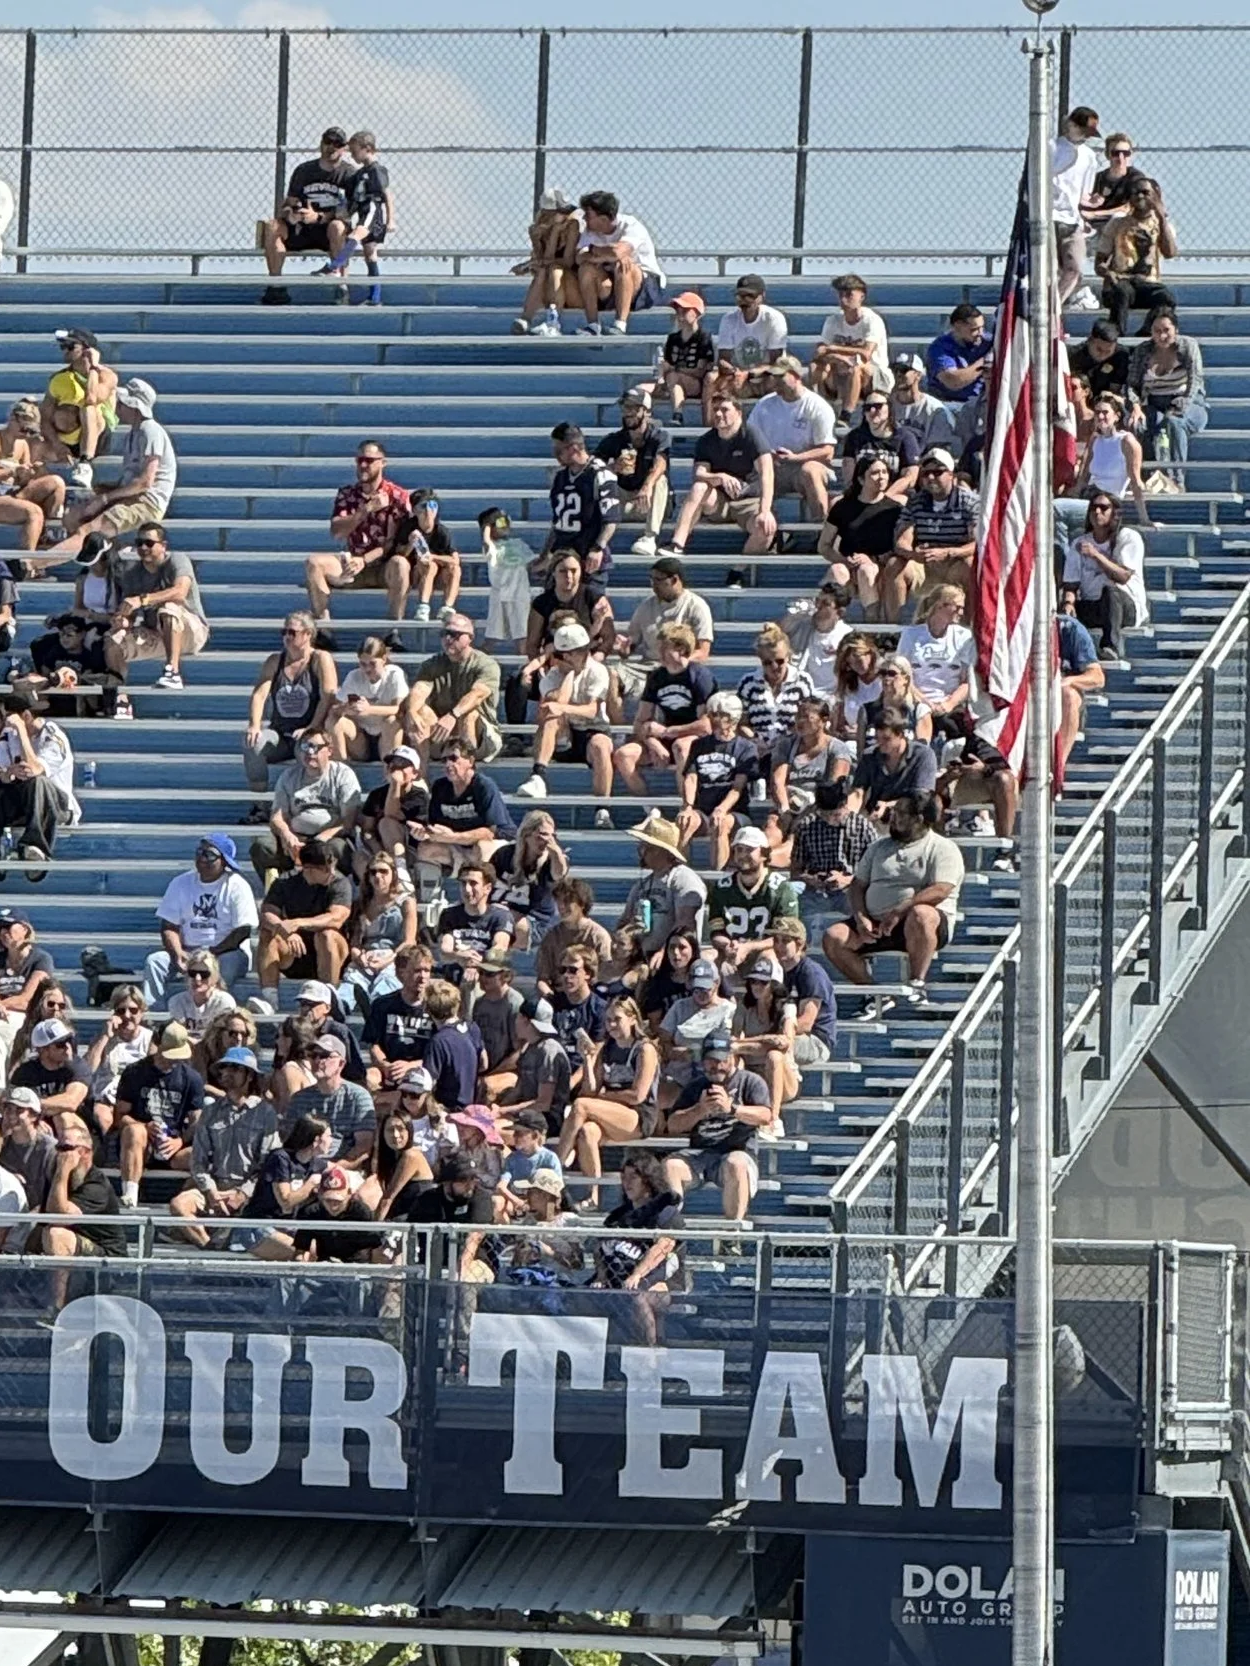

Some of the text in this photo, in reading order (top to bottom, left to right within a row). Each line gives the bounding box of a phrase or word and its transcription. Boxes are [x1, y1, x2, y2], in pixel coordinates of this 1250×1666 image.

[48, 1294, 409, 1491] OUR
[468, 1313, 1009, 1510] TEAM
[903, 1564, 1065, 1601] DOL
[1175, 1570, 1220, 1605] DOLAN
[902, 1600, 1064, 1617] AUTO GRP
[943, 1617, 966, 1626] AND
[970, 1618, 996, 1626] JOIN
